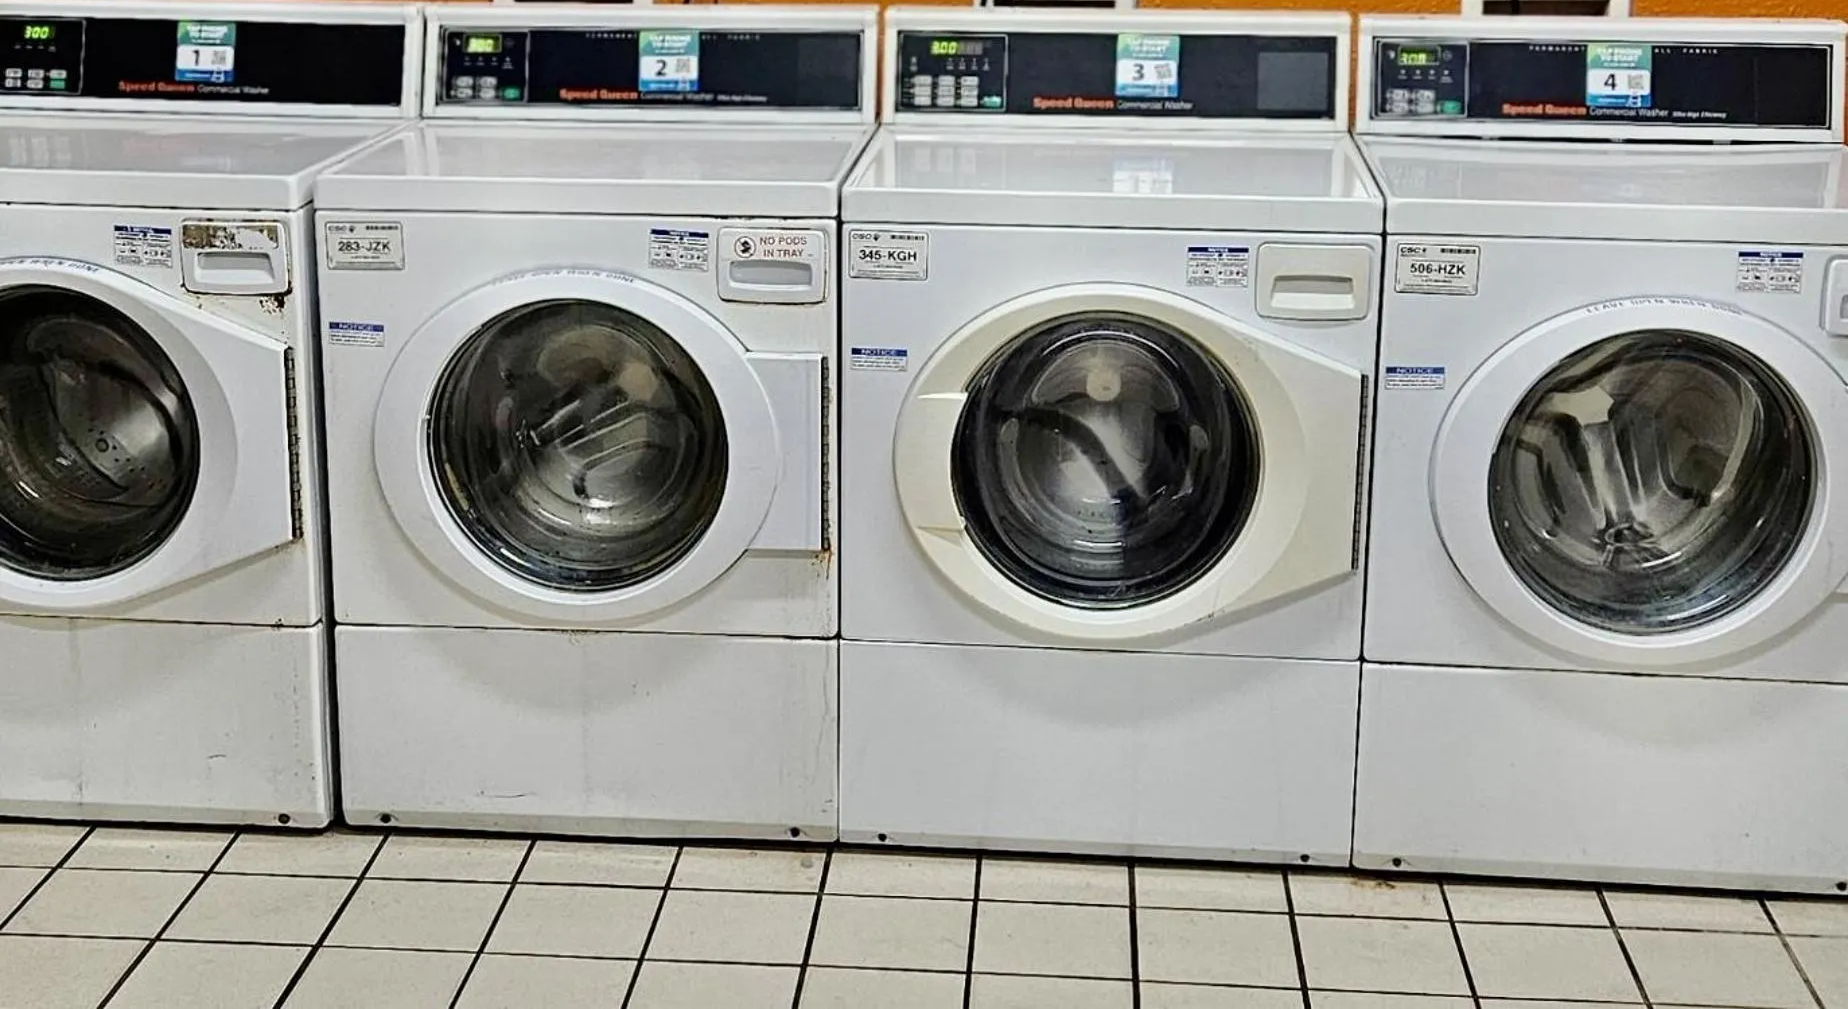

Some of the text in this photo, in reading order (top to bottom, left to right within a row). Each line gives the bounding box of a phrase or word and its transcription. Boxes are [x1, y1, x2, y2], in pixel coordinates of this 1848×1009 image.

[192, 49, 200, 66] 1
[655, 59, 668, 77] 2
[1132, 63, 1144, 81] 3
[118, 80, 155, 93] Speed
[158, 80, 195, 92] Queen
[1604, 73, 1617, 91] 4
[560, 88, 597, 101] Speed
[600, 88, 638, 100] Queen
[1033, 97, 1072, 110] Speed
[1074, 97, 1114, 109] Queen
[1117, 100, 1163, 109] Commercial
[1502, 103, 1543, 116] Speed
[1545, 103, 1587, 115] Queen
[1589, 107, 1635, 116] Commercial
[1638, 108, 1669, 117] Washer
[338, 240, 391, 252] 283-JZK
[760, 236, 807, 246] NO PODS
[763, 249, 804, 258] IN TRAY
[859, 249, 917, 262] 345-KGH
[1410, 262, 1466, 276] 506-HZK
[1396, 367, 1434, 375] NOTICE
